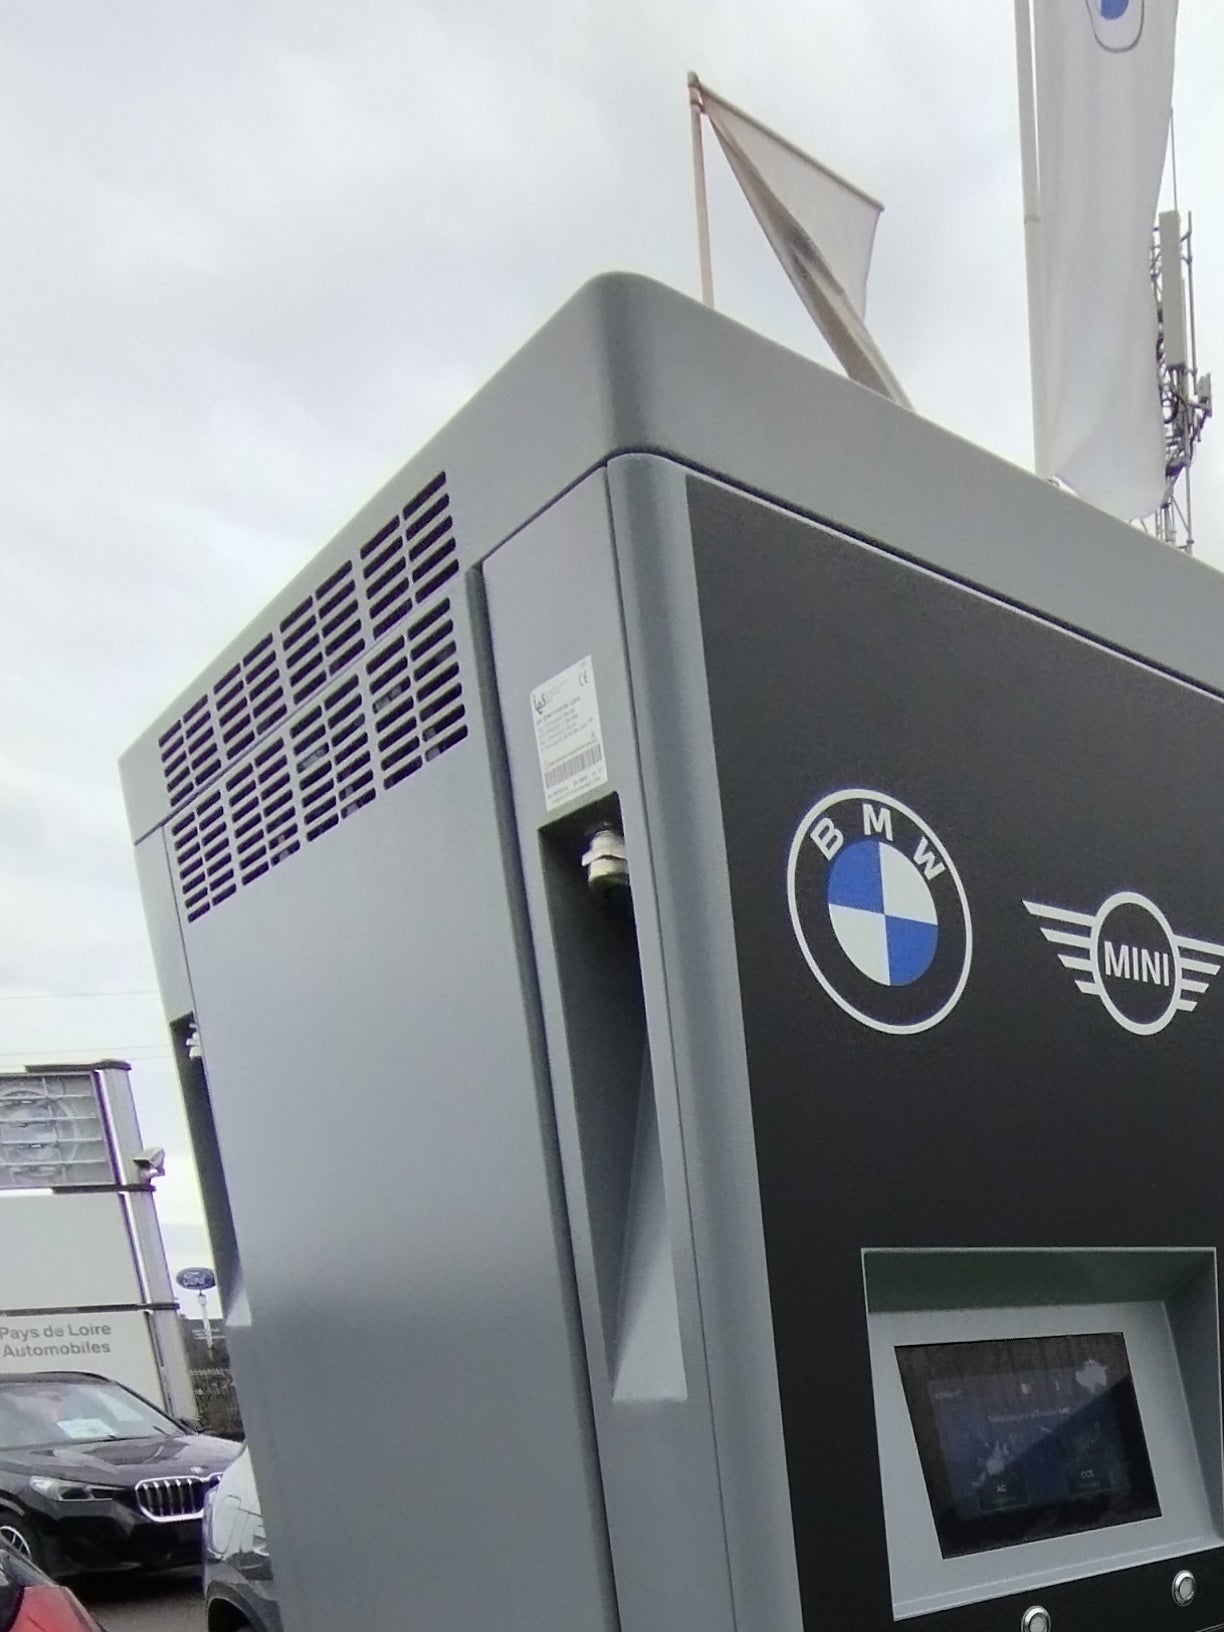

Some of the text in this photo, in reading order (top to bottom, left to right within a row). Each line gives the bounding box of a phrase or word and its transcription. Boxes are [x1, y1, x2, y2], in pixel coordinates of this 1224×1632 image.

[809, 802, 945, 880] BMW
[1104, 941, 1170, 988] MINI
[0, 1323, 112, 1342] Pays de Loire
[3, 1341, 111, 1358] Automobiles
